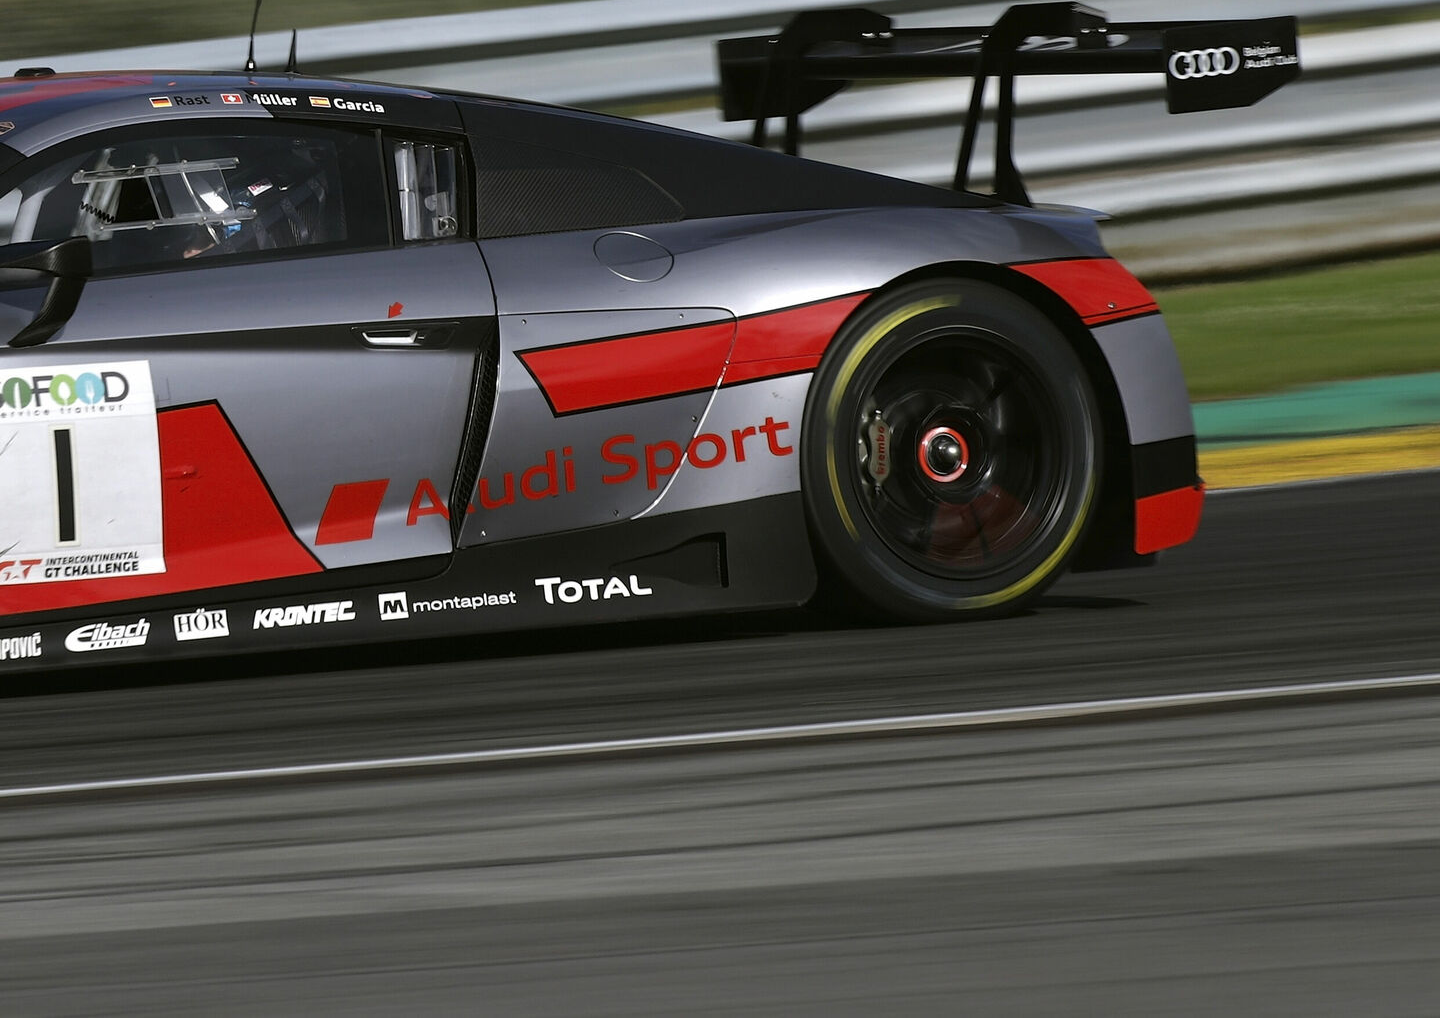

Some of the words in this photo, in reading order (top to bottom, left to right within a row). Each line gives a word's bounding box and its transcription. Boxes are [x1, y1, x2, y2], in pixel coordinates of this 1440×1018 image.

[174, 95, 211, 107] Rast
[246, 93, 298, 108] Müller
[333, 97, 386, 115] Garcia
[60, 403, 124, 415] traiteur
[406, 445, 578, 527] Audi
[600, 416, 795, 490] Sport
[45, 550, 139, 566] INTERCONTINENTAL
[44, 566, 63, 579] GT
[64, 560, 140, 577] CHALLENGE
[534, 574, 654, 605] TOTAL
[412, 590, 517, 615] montaplast
[177, 607, 226, 634] HÖR
[252, 600, 357, 630] KRONTEC
[63, 616, 151, 653] Eibach
